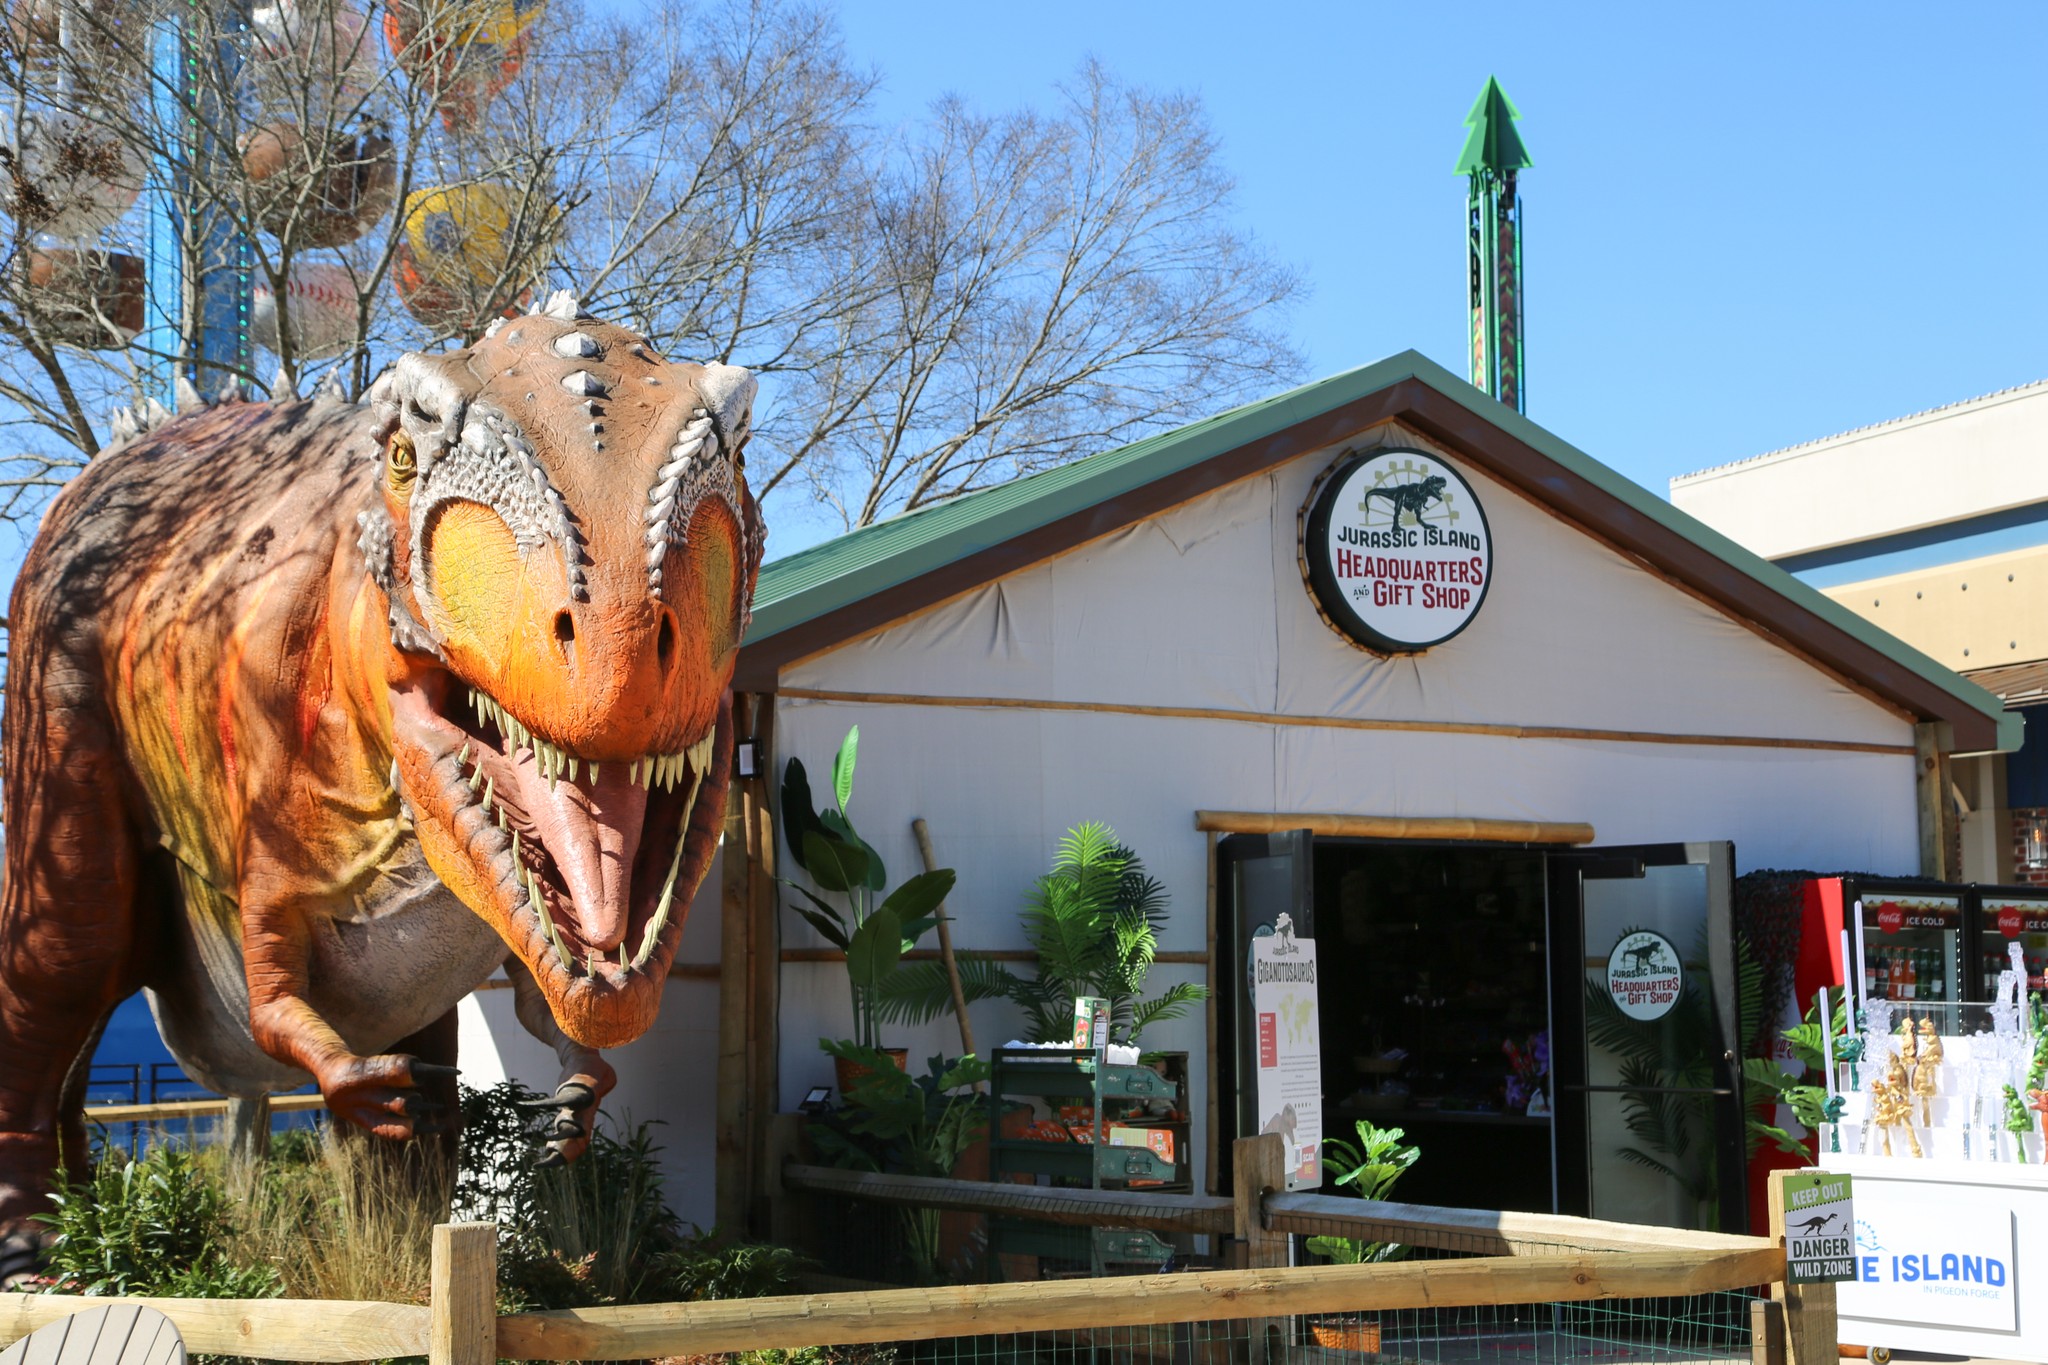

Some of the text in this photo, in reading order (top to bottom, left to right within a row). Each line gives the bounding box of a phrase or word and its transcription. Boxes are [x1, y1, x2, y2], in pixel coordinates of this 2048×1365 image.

[1337, 526, 1481, 552] JURASSIC ISLAND
[1337, 548, 1484, 586] HEADQUARTERS
[1353, 580, 1471, 610] AND GIFT SHOP
[1906, 916, 1920, 925] ICE
[1922, 917, 1945, 926] COLD
[2025, 920, 2039, 929] ICE
[1258, 959, 1315, 985] GIGANOTOSAURUS
[1612, 966, 1677, 978] JURASSIC ISLAND
[1612, 977, 1679, 993] HEADQUARTERS
[1628, 993, 1647, 1005] GIFT
[1650, 992, 1673, 1004] SHOP
[1791, 1182, 1844, 1207] KEEP OUT
[1793, 1238, 1850, 1259] DANGER
[1793, 1260, 1852, 1278] WILD ZONE
[1893, 1253, 2006, 1288] ISLAND
[1923, 1284, 2001, 1300] IN PIGEON FORGE
